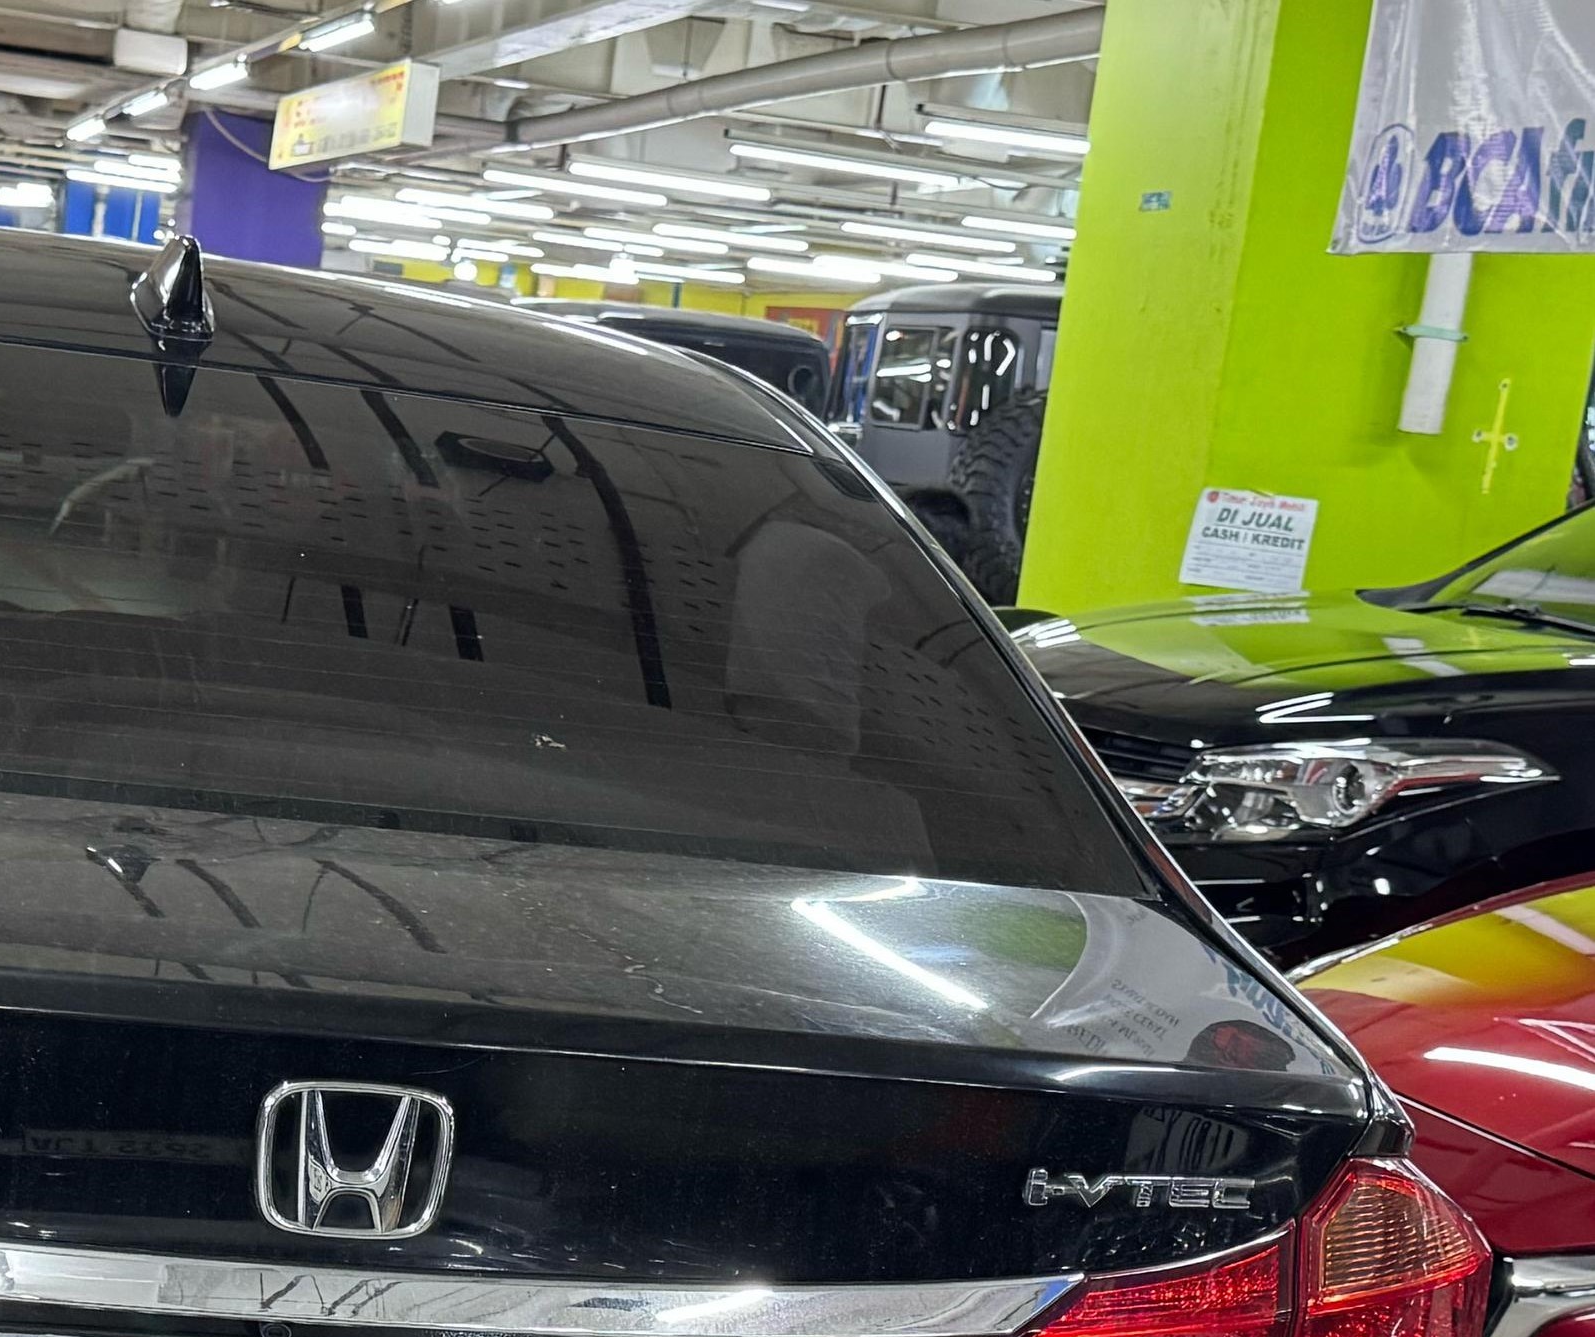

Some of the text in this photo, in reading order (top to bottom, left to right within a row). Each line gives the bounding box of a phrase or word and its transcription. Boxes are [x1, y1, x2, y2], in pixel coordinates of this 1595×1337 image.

[1217, 508, 1295, 532] DI JUAL
[1202, 526, 1240, 543] CASH
[1251, 533, 1305, 550] KREDIT
